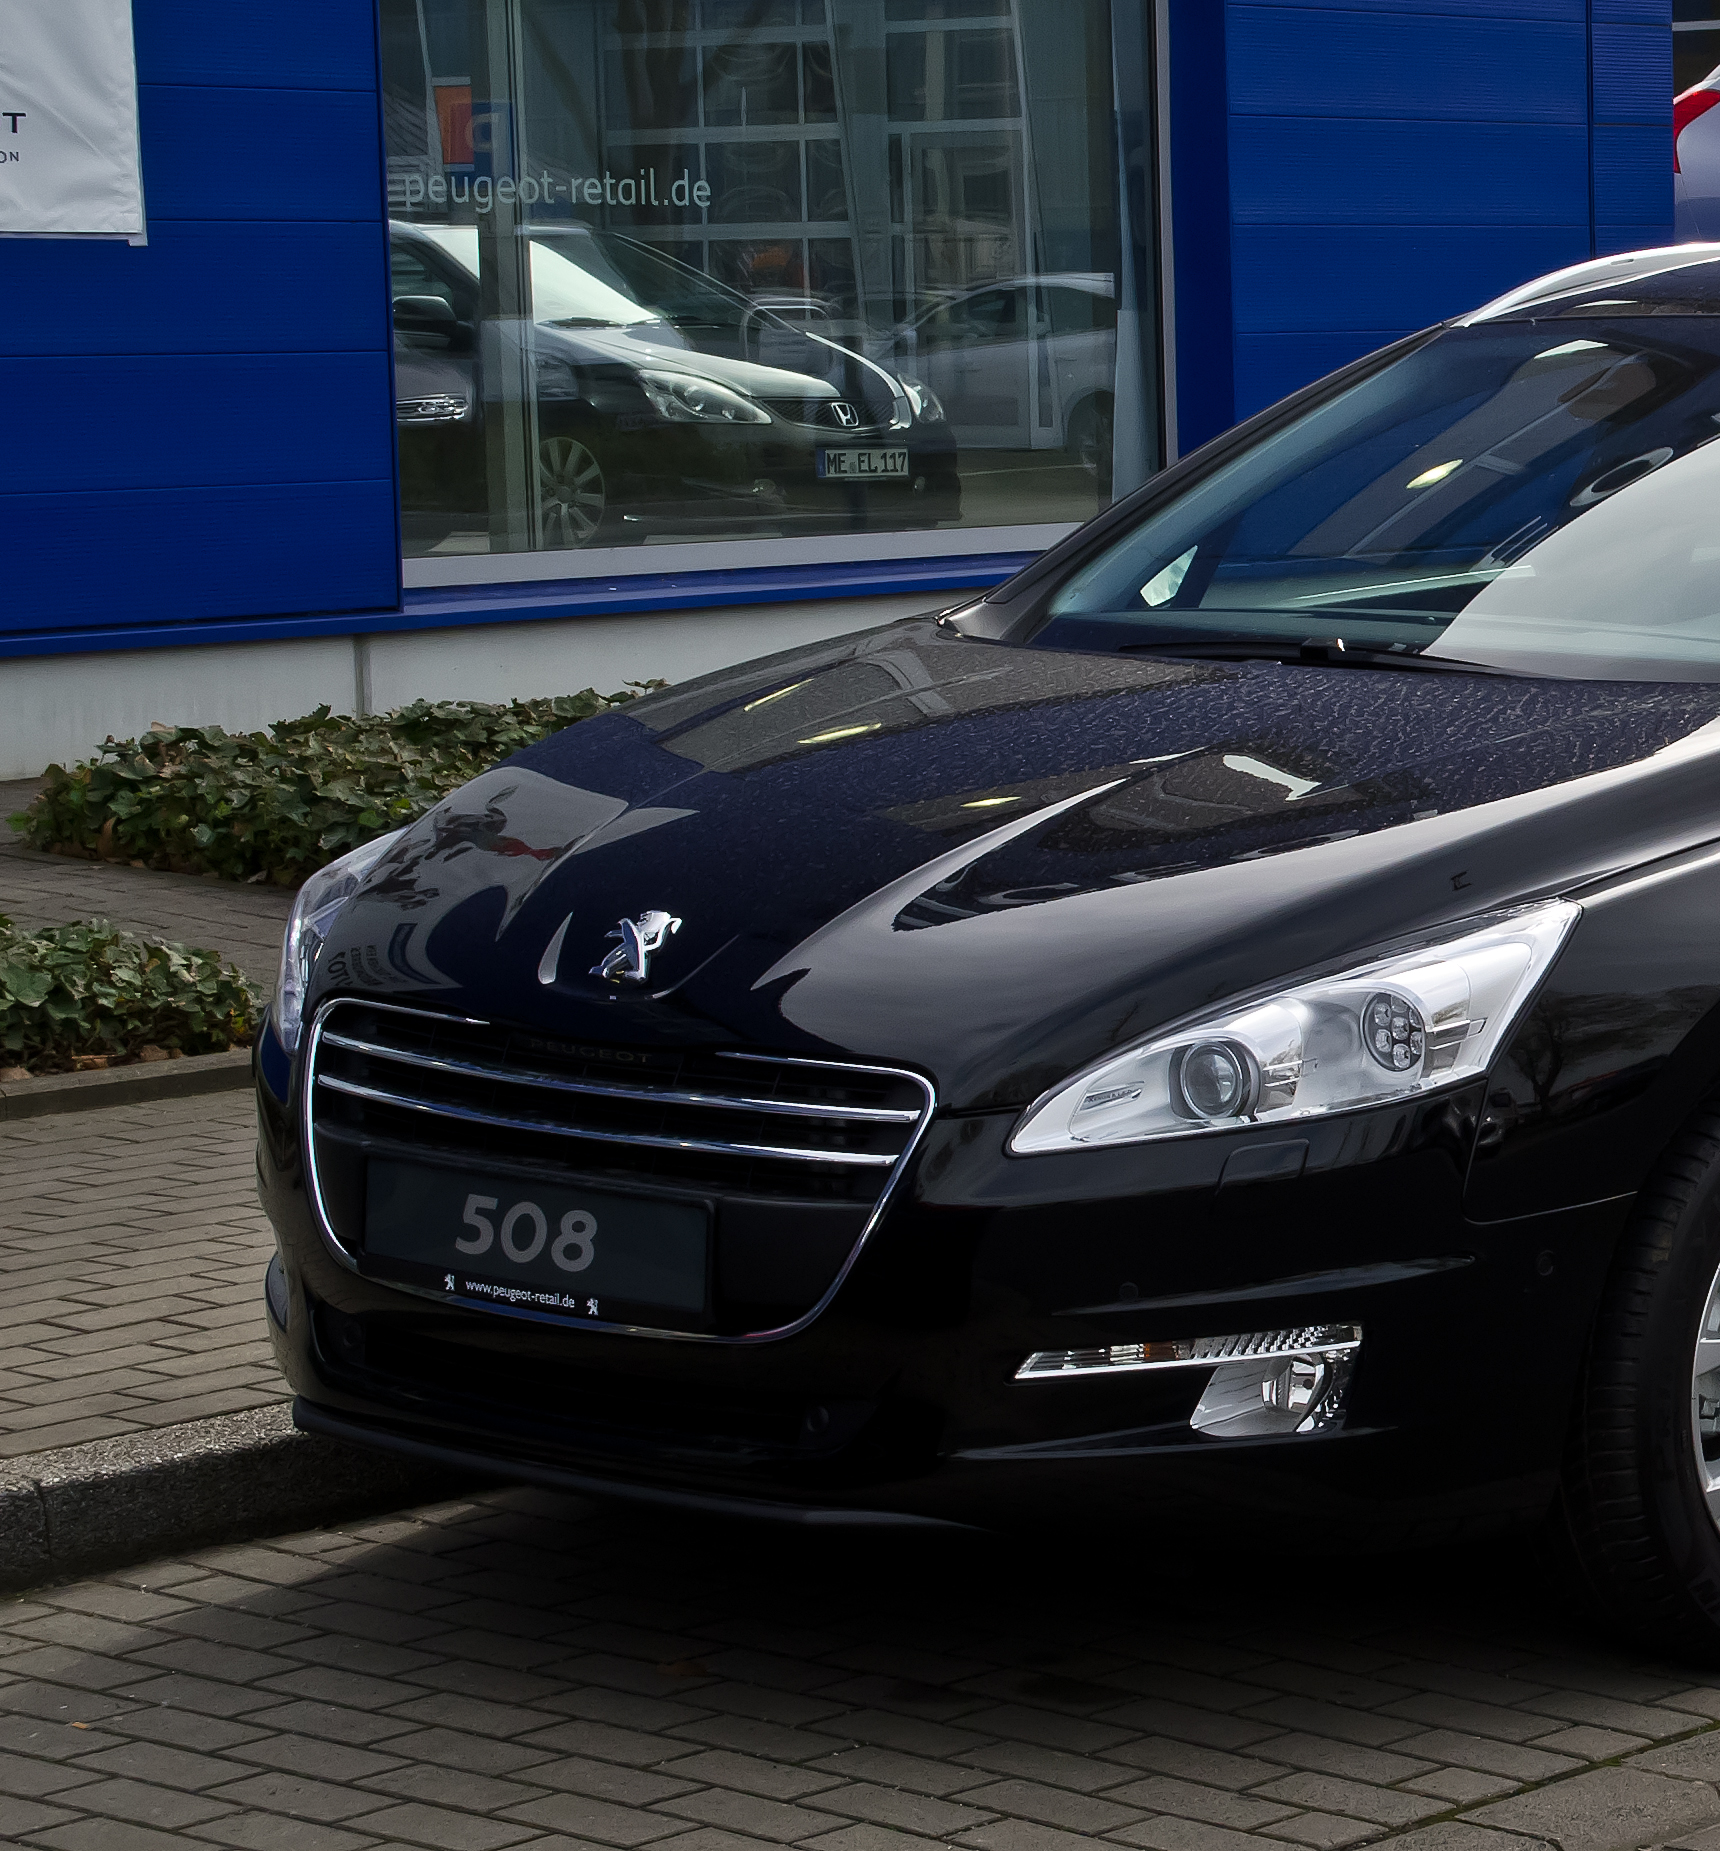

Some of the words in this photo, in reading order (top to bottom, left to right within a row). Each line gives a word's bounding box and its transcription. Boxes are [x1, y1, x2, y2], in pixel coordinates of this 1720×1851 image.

[405, 167, 711, 213] peugeot-retail.de
[827, 453, 847, 474] ME
[858, 453, 878, 473] EL
[881, 452, 907, 472] 117
[529, 1037, 652, 1063] PEUGEOT
[455, 1193, 598, 1272] 508
[465, 1280, 575, 1308] www.peugeot-retail.de
